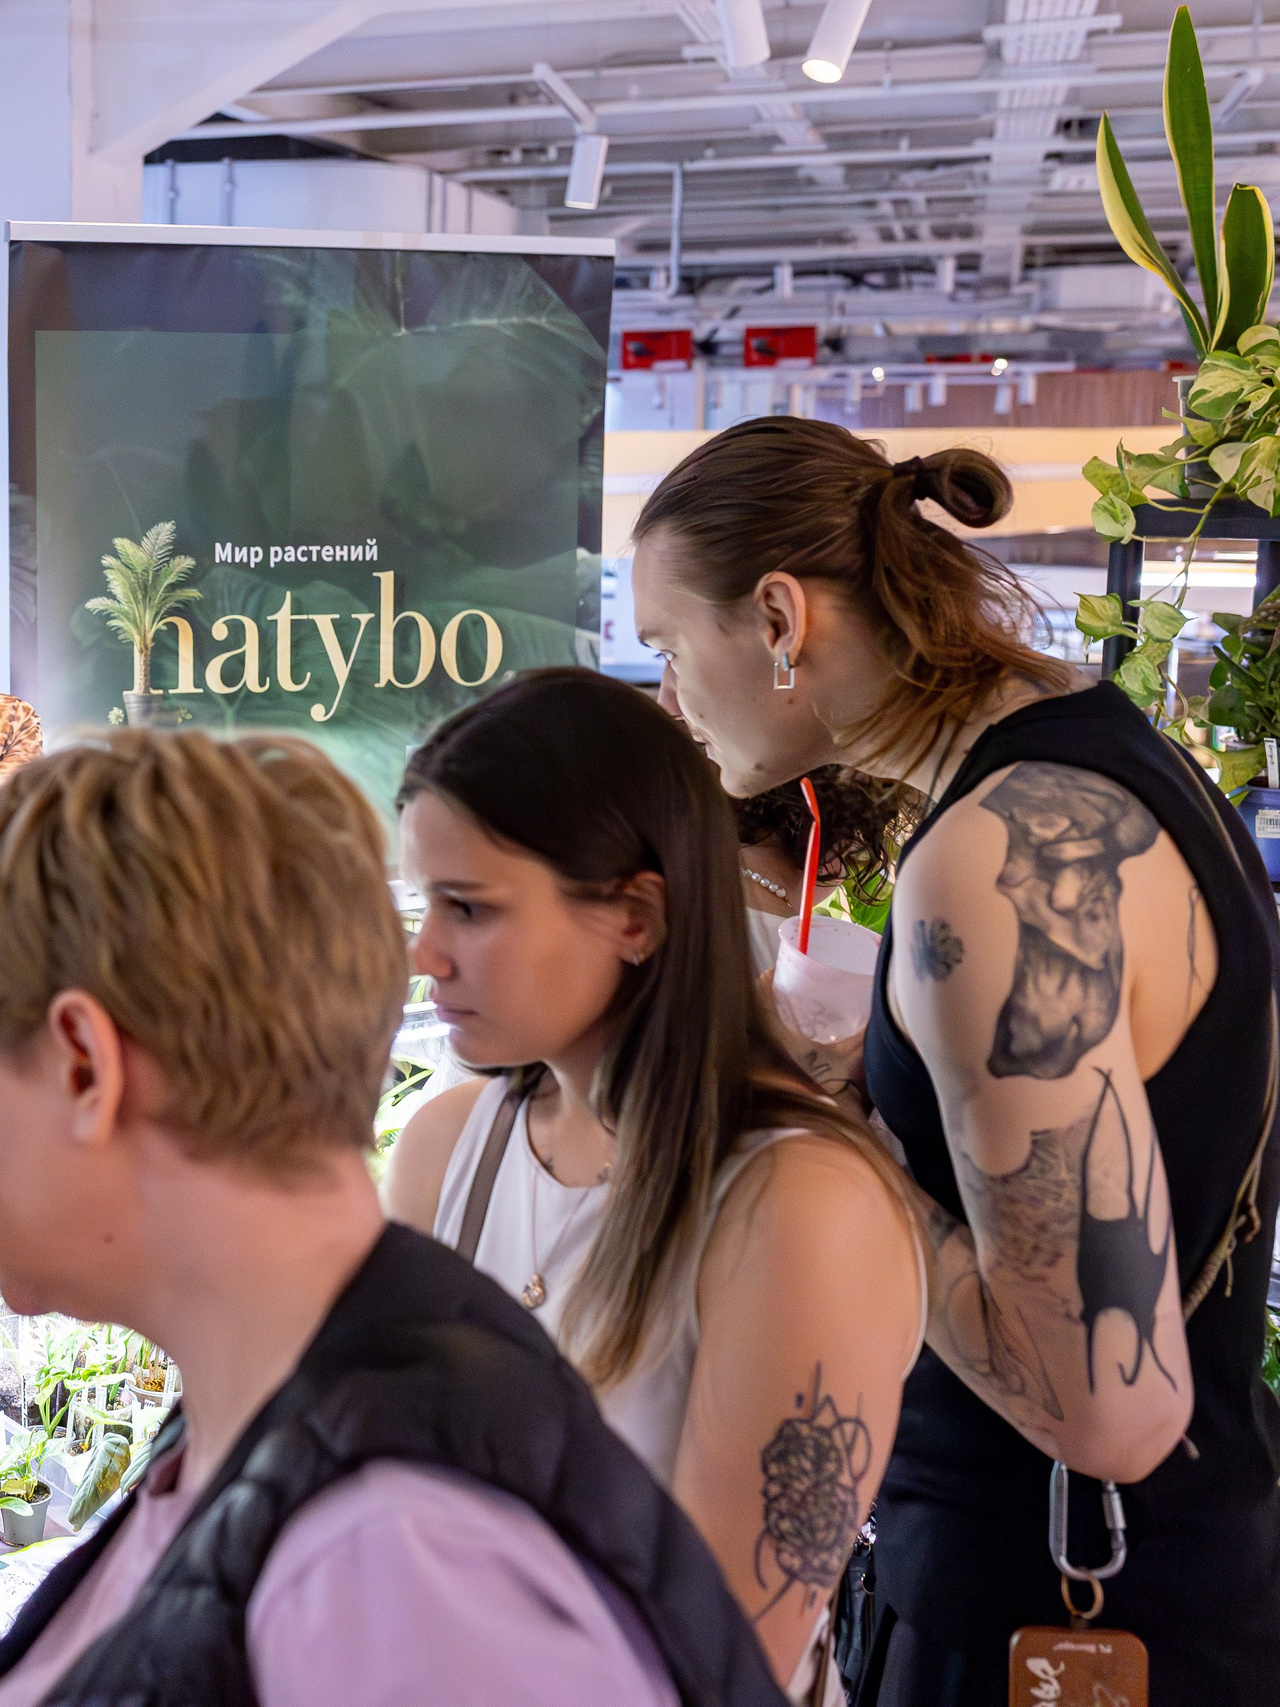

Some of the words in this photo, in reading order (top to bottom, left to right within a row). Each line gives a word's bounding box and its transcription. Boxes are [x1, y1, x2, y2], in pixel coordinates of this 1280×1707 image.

[214, 541, 263, 568] Мир
[270, 538, 378, 568] растений
[123, 570, 503, 722] natybo
